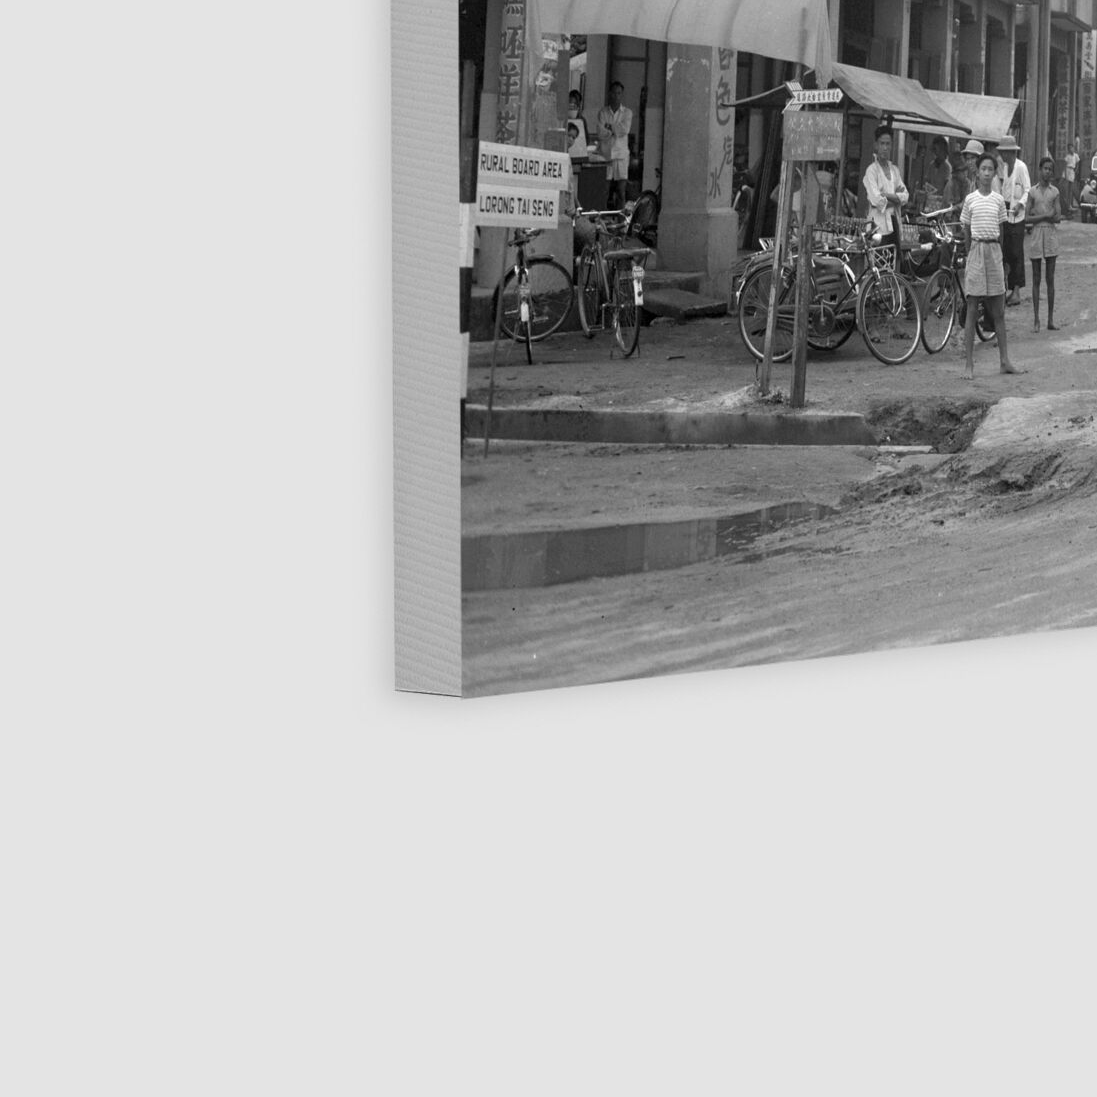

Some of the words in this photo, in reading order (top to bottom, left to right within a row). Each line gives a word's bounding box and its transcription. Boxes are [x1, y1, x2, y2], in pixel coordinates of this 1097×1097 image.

[480, 153, 509, 174] RURAL
[512, 158, 540, 176] BOARD
[542, 162, 563, 178] AREA
[480, 195, 515, 214] LORONG
[517, 198, 530, 215] TAI
[532, 199, 554, 217] SENG
